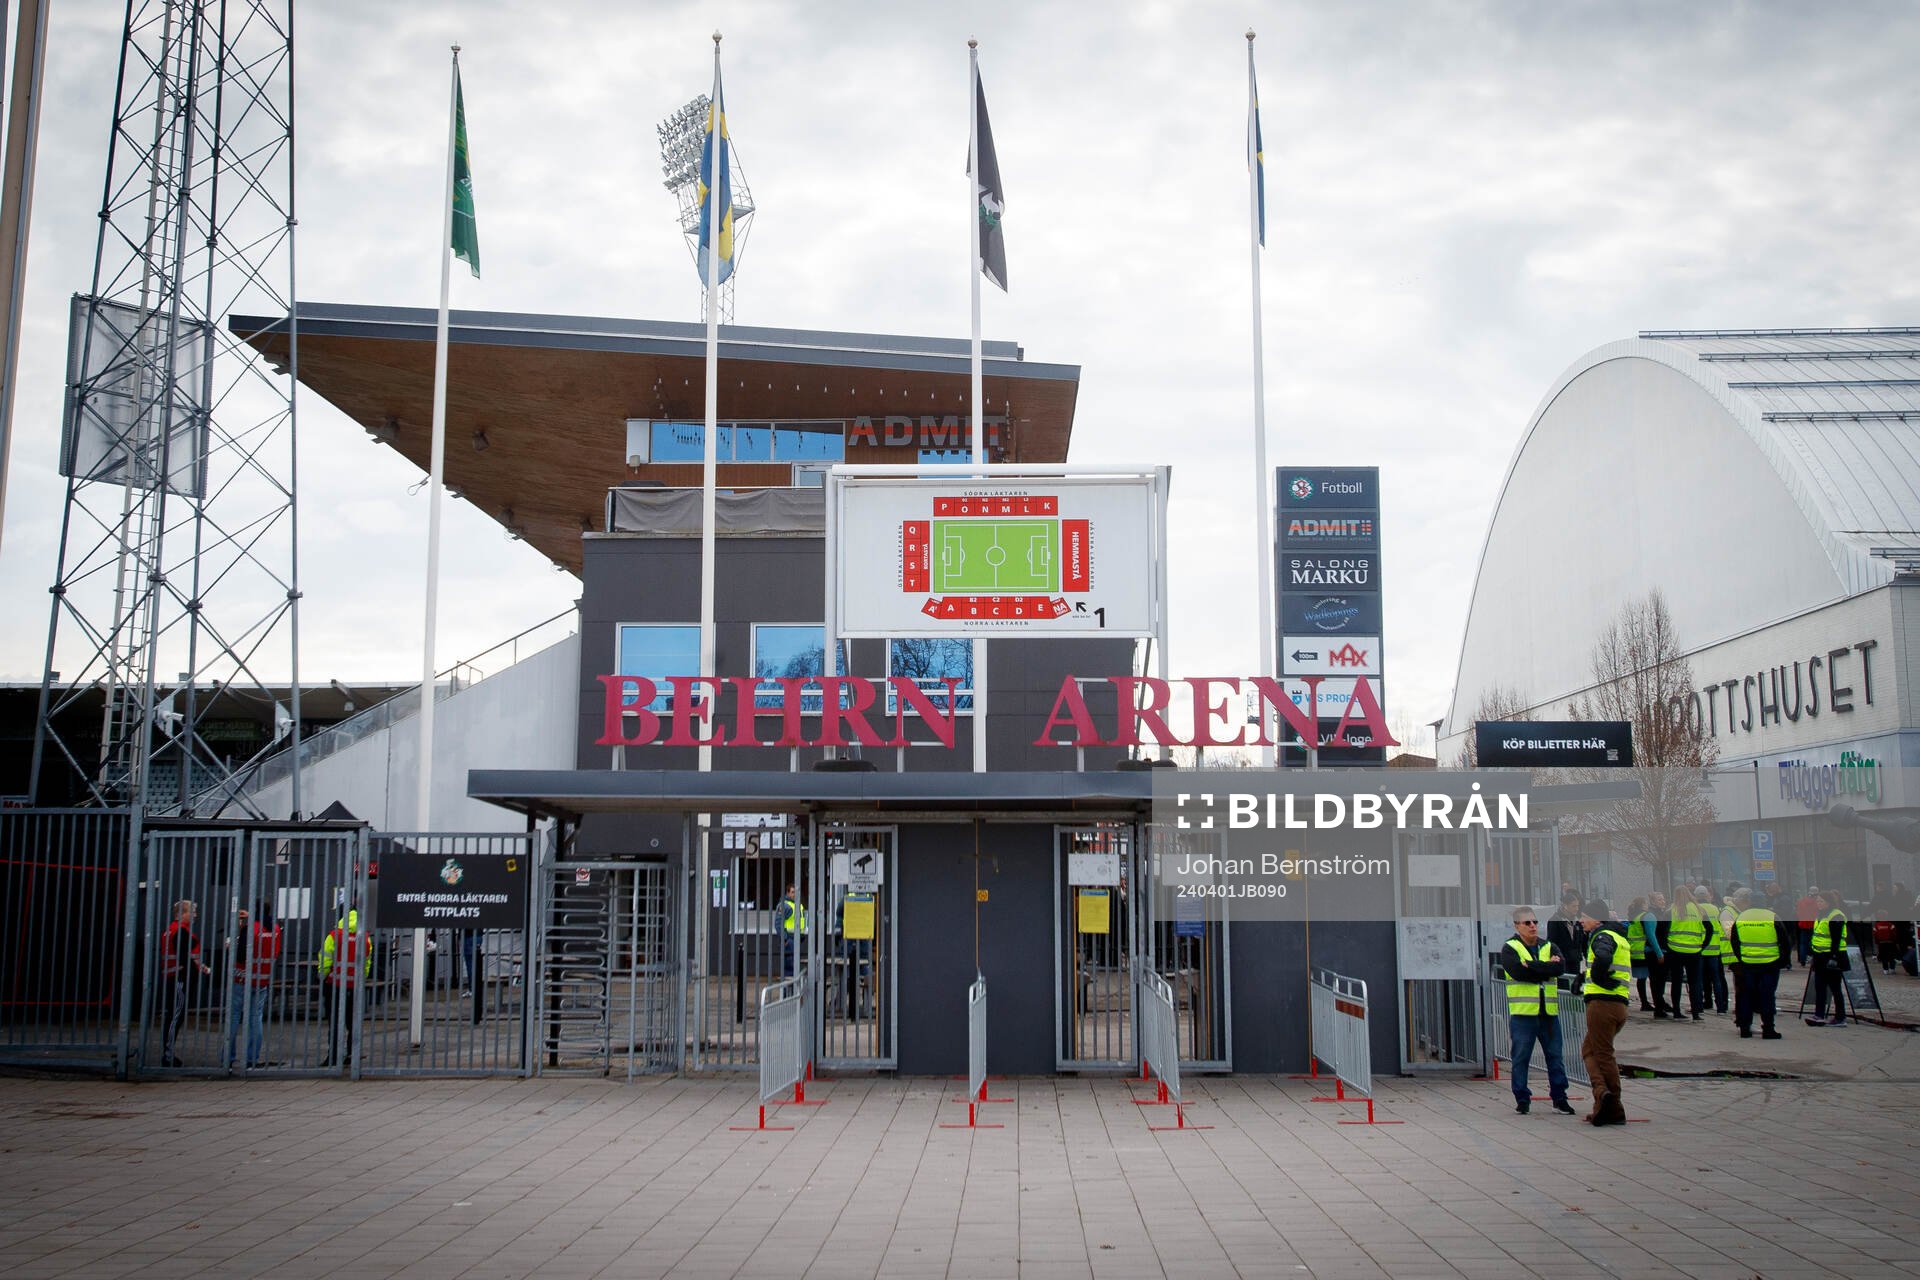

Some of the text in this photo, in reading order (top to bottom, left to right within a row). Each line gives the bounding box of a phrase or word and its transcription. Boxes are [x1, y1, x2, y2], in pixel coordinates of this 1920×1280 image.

[848, 416, 1006, 446] ADMIT
[1321, 482, 1363, 494] Fotboll
[1044, 502, 1051, 510] K
[909, 526, 916, 535] Q
[1287, 519, 1360, 536] ADMIT
[909, 544, 916, 552] R
[1072, 531, 1082, 580] HEMMASTÅ
[909, 562, 916, 570] S
[1290, 559, 1369, 569] SALONG
[1291, 569, 1369, 584] MARKU
[909, 579, 915, 588] T
[947, 604, 954, 612] A
[971, 607, 977, 615] B
[993, 607, 999, 615] C
[1016, 607, 1023, 615] D
[1094, 608, 1105, 628] 1
[1328, 643, 1368, 667] MAX
[595, 674, 1401, 749] BEHRN ARENA
[1503, 738, 1606, 749] KÖP BILJETTER HÄR
[746, 833, 758, 856] 5
[1757, 833, 1769, 848] P
[277, 840, 289, 861] 4
[397, 892, 508, 903] ENTRÉ NORRA LÄKTAREN
[424, 907, 480, 917] SITTPLATS
